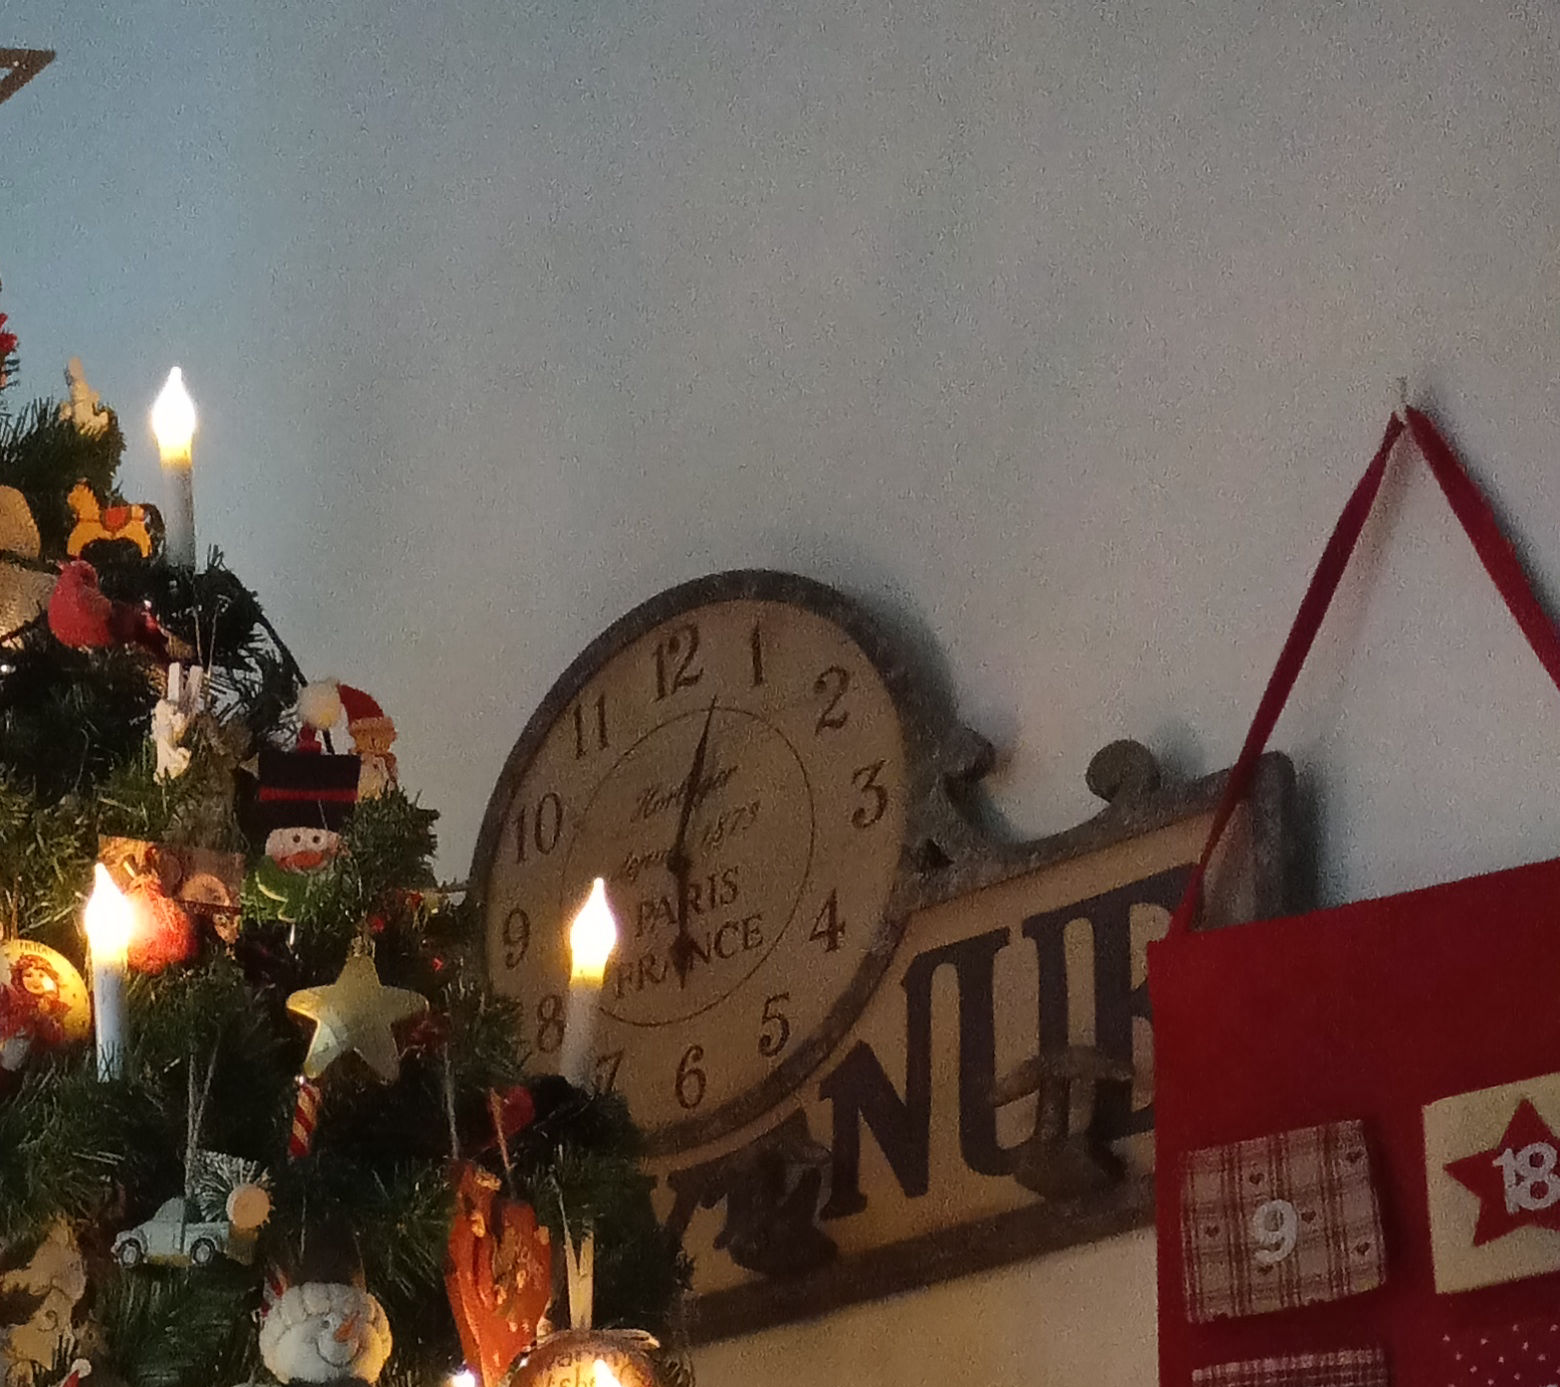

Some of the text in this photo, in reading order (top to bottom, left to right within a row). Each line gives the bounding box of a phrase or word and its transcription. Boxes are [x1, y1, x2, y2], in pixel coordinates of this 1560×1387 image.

[650, 622, 705, 701] 12
[747, 621, 765, 688] 1
[573, 694, 609, 760] 11
[814, 665, 850, 735] 2
[513, 791, 564, 864] 10
[851, 759, 889, 829] 3
[633, 865, 740, 938] PARIS
[808, 887, 846, 954] 4
[502, 907, 531, 970] 9
[536, 993, 566, 1054] 8
[757, 991, 792, 1058] 5
[593, 1046, 625, 1094] 7
[674, 1044, 707, 1110] 6
[1492, 1141, 1560, 1214] 18
[1255, 1199, 1298, 1263] 9
